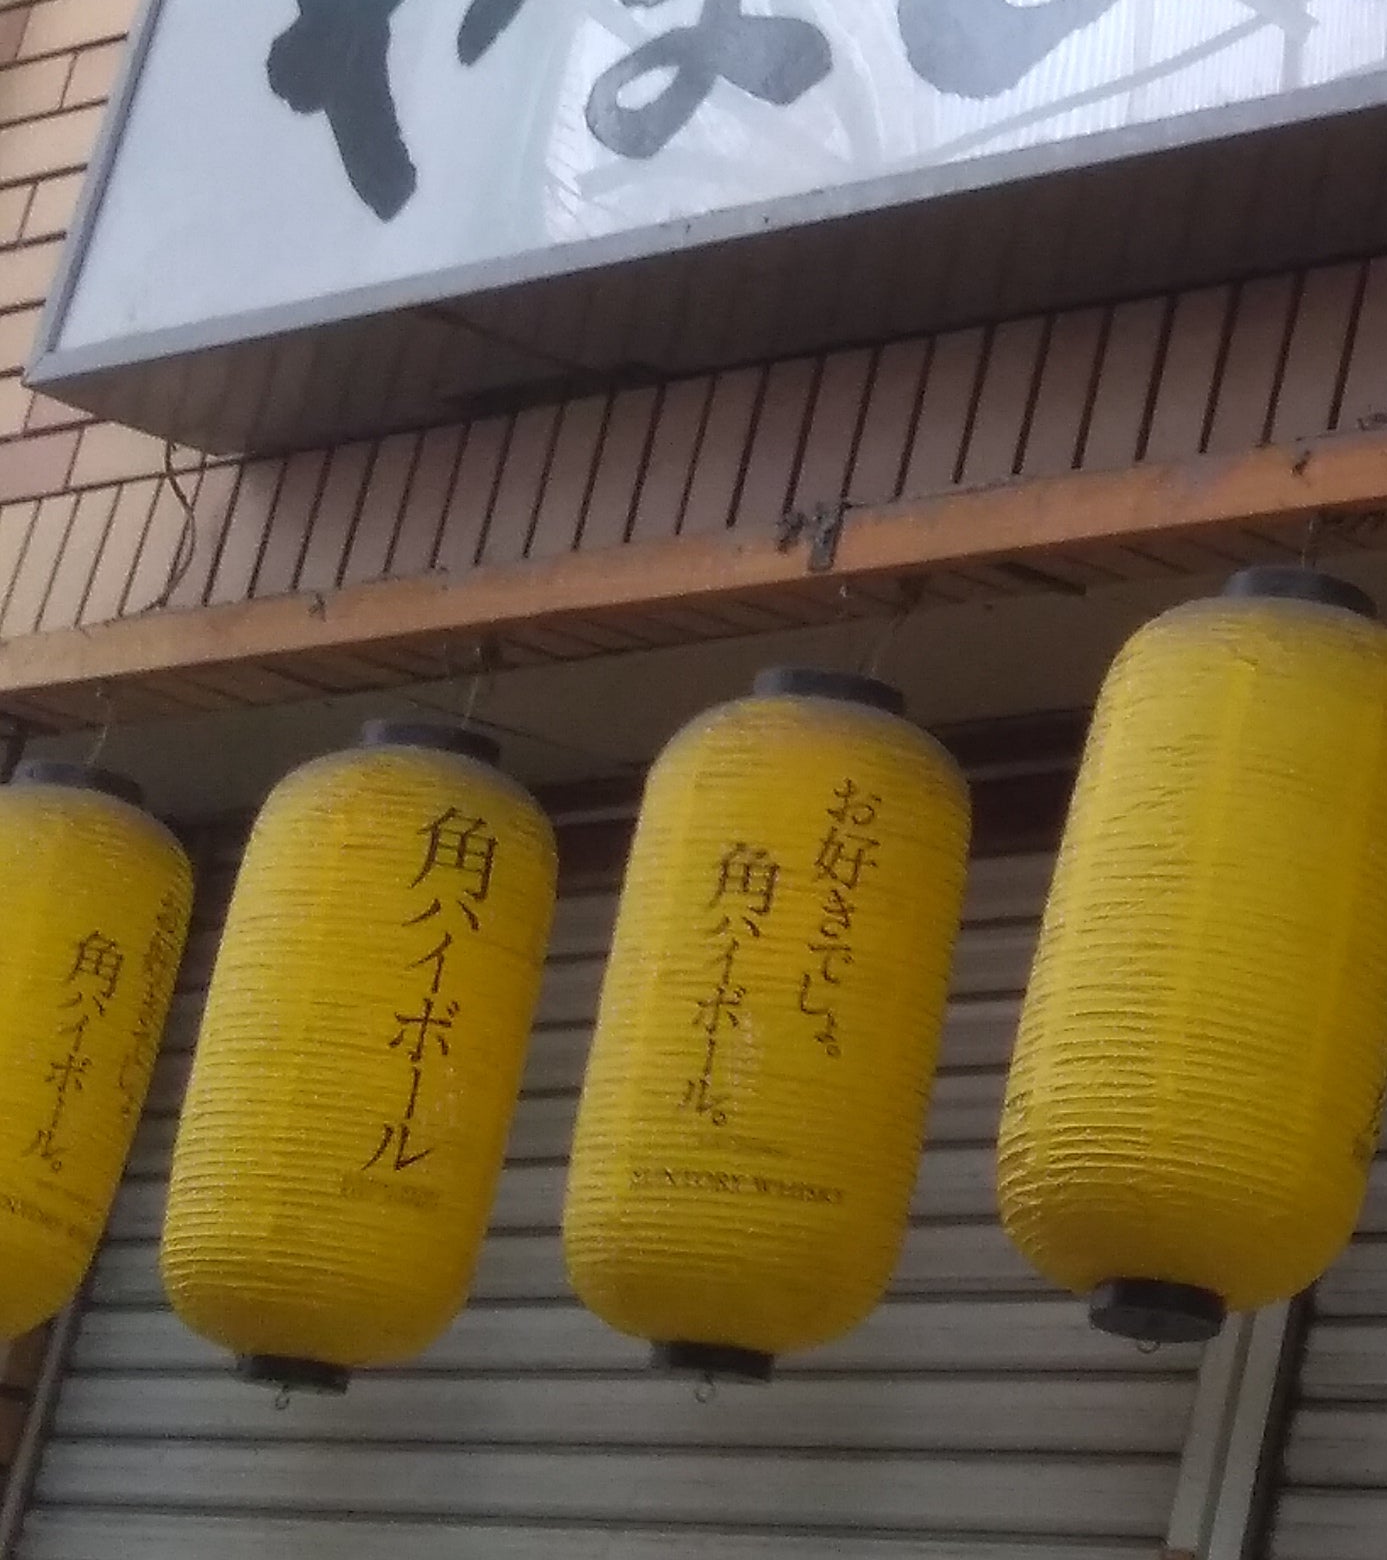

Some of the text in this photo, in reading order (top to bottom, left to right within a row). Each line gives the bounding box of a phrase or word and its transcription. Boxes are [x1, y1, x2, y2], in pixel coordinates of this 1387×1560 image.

[361, 804, 499, 1172] 角ハイボール
[676, 841, 781, 1128] 角ハイボール。
